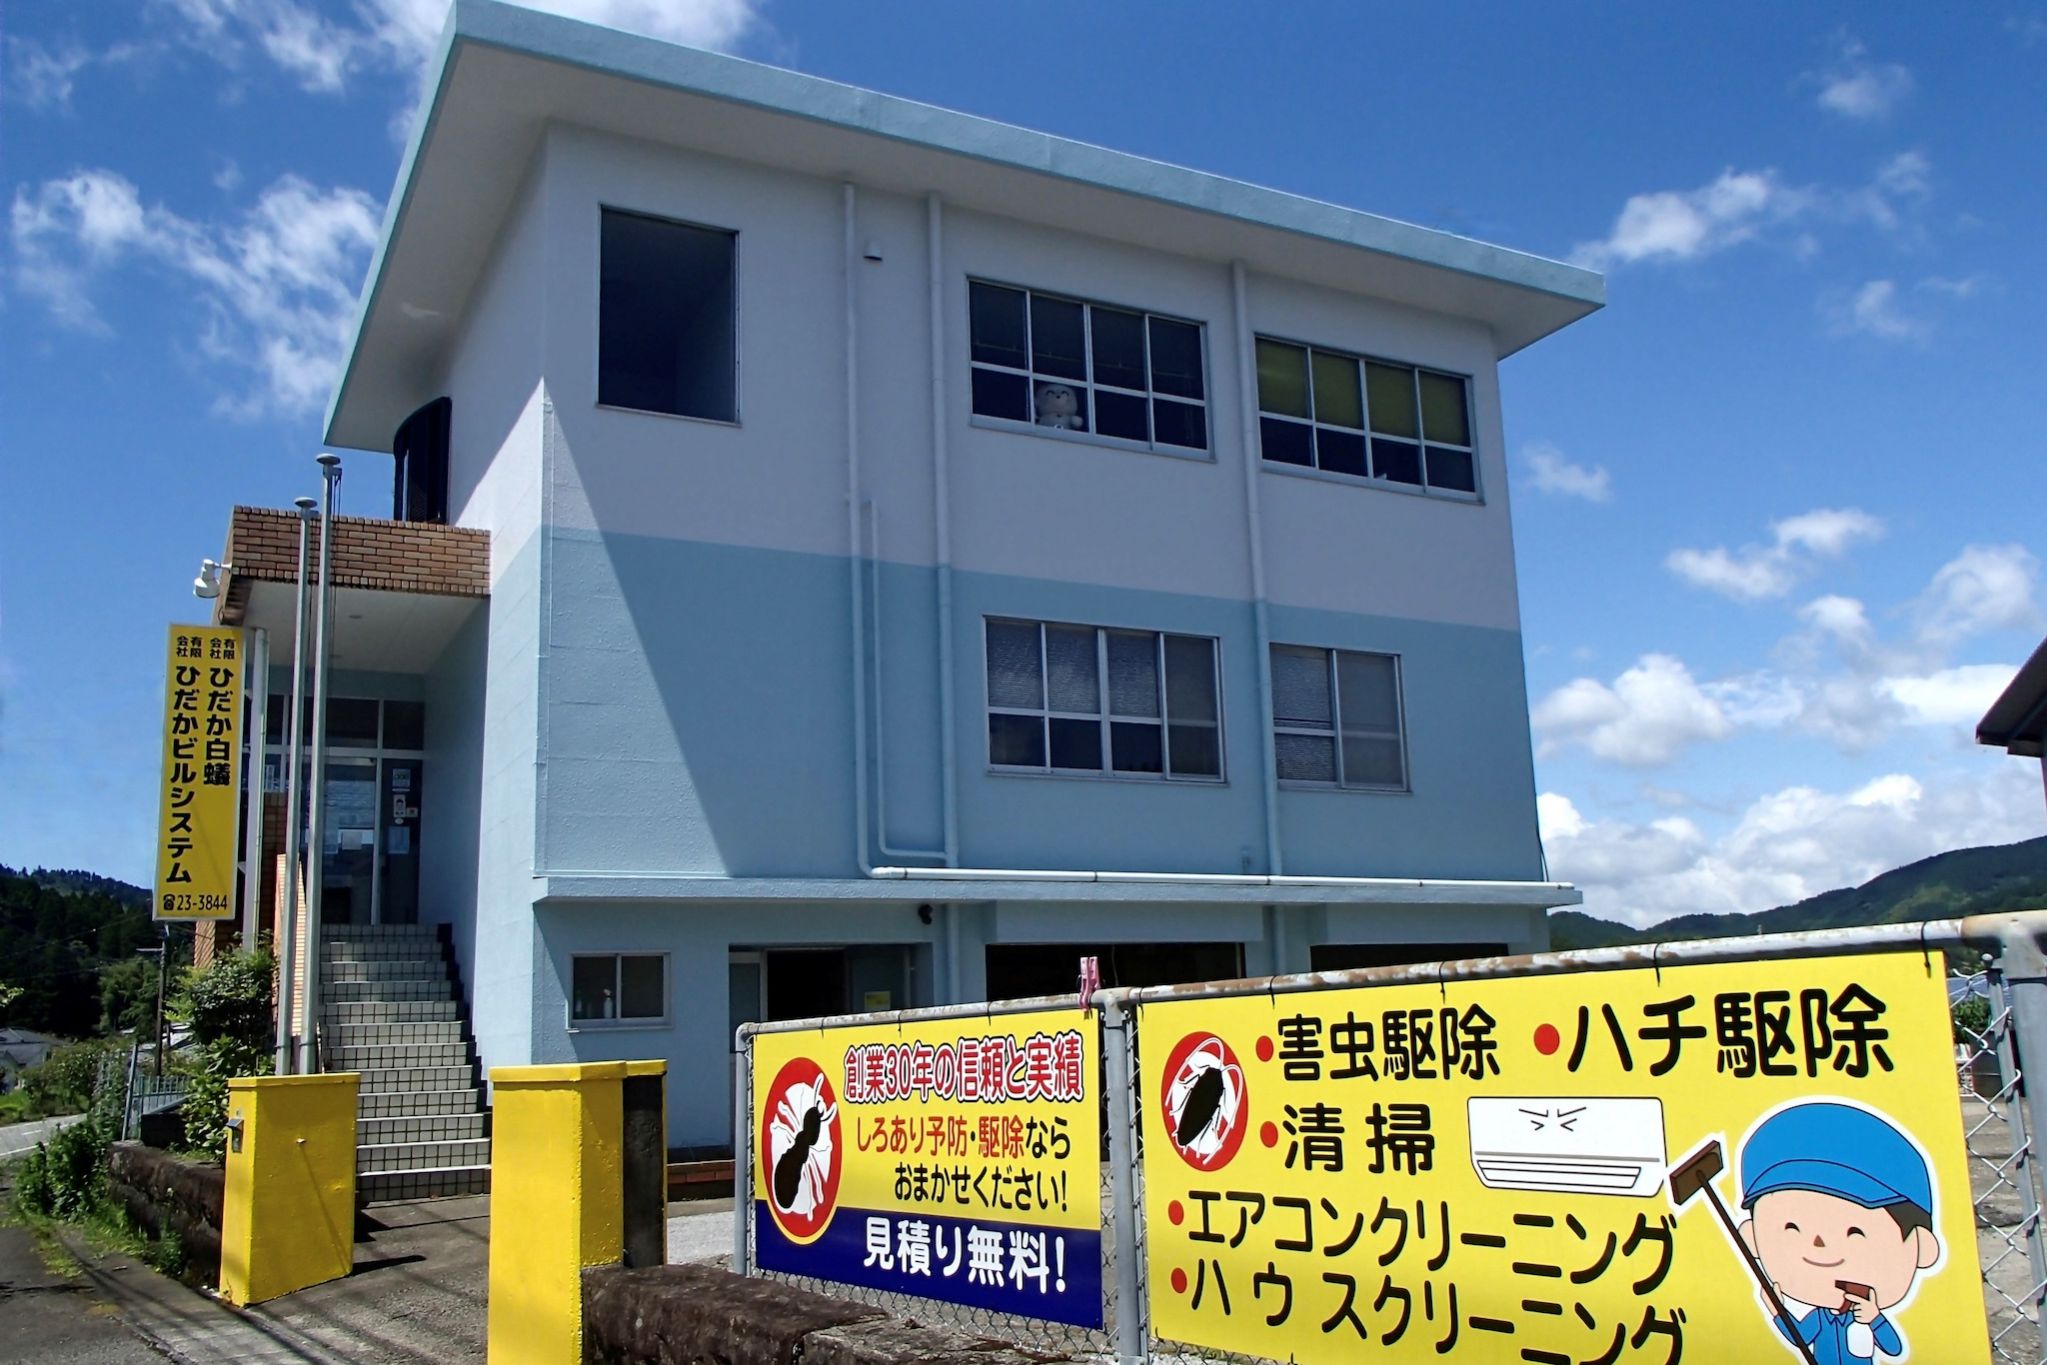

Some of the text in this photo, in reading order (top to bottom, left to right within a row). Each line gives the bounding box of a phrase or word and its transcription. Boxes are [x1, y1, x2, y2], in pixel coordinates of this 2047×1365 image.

[166, 666, 201, 883] ひだかビルシステム
[177, 894, 228, 911] 23-3844
[844, 1030, 1084, 1104] 創業30年の信頼と実績
[1277, 982, 1894, 1082] 害虫駆除 ハチ駆除
[857, 1114, 1071, 1160] しろあり予防・駆除なら
[1282, 1102, 1435, 1175] 清掃
[895, 1161, 1068, 1212] おまかせください!
[863, 1216, 1066, 1294] 見積り無料!
[1188, 1190, 1677, 1295] エアコンクリーニング
